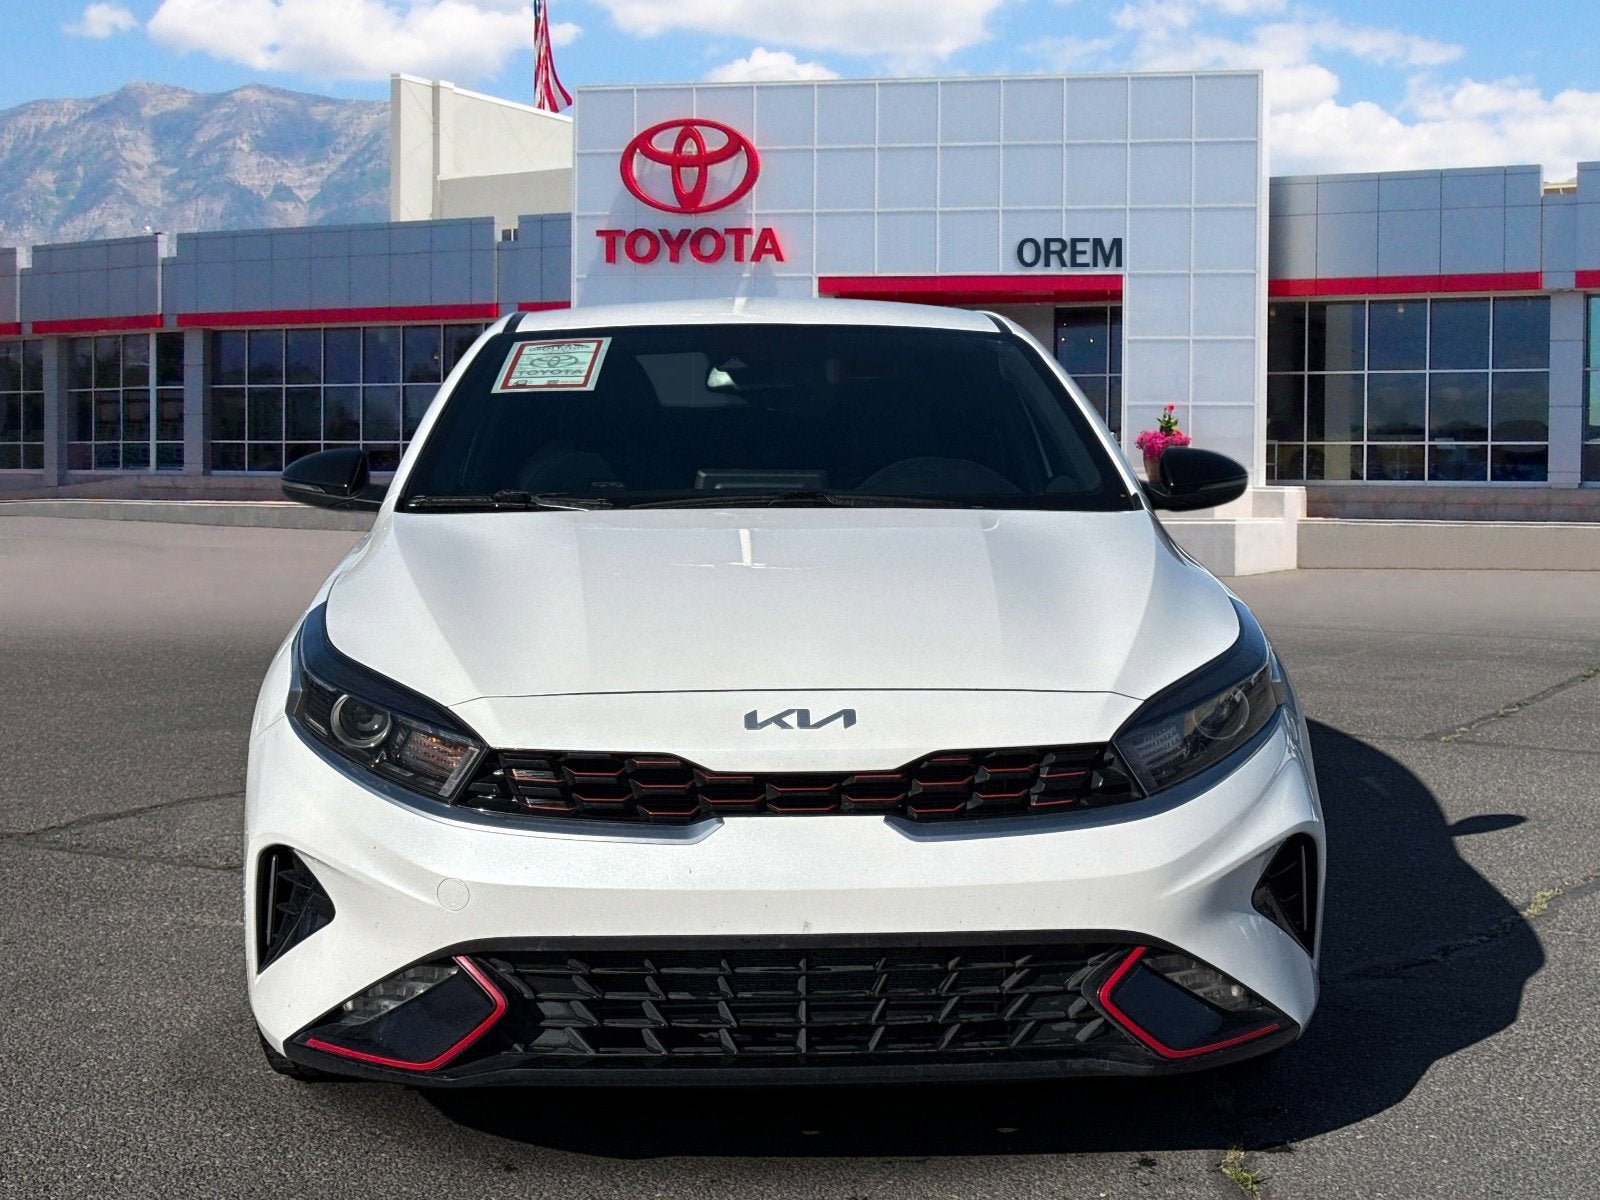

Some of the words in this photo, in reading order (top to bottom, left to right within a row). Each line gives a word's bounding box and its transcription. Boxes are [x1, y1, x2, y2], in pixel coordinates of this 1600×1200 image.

[596, 227, 785, 265] TOYOTA
[1017, 237, 1123, 268] OREM
[743, 708, 857, 730] KIA
